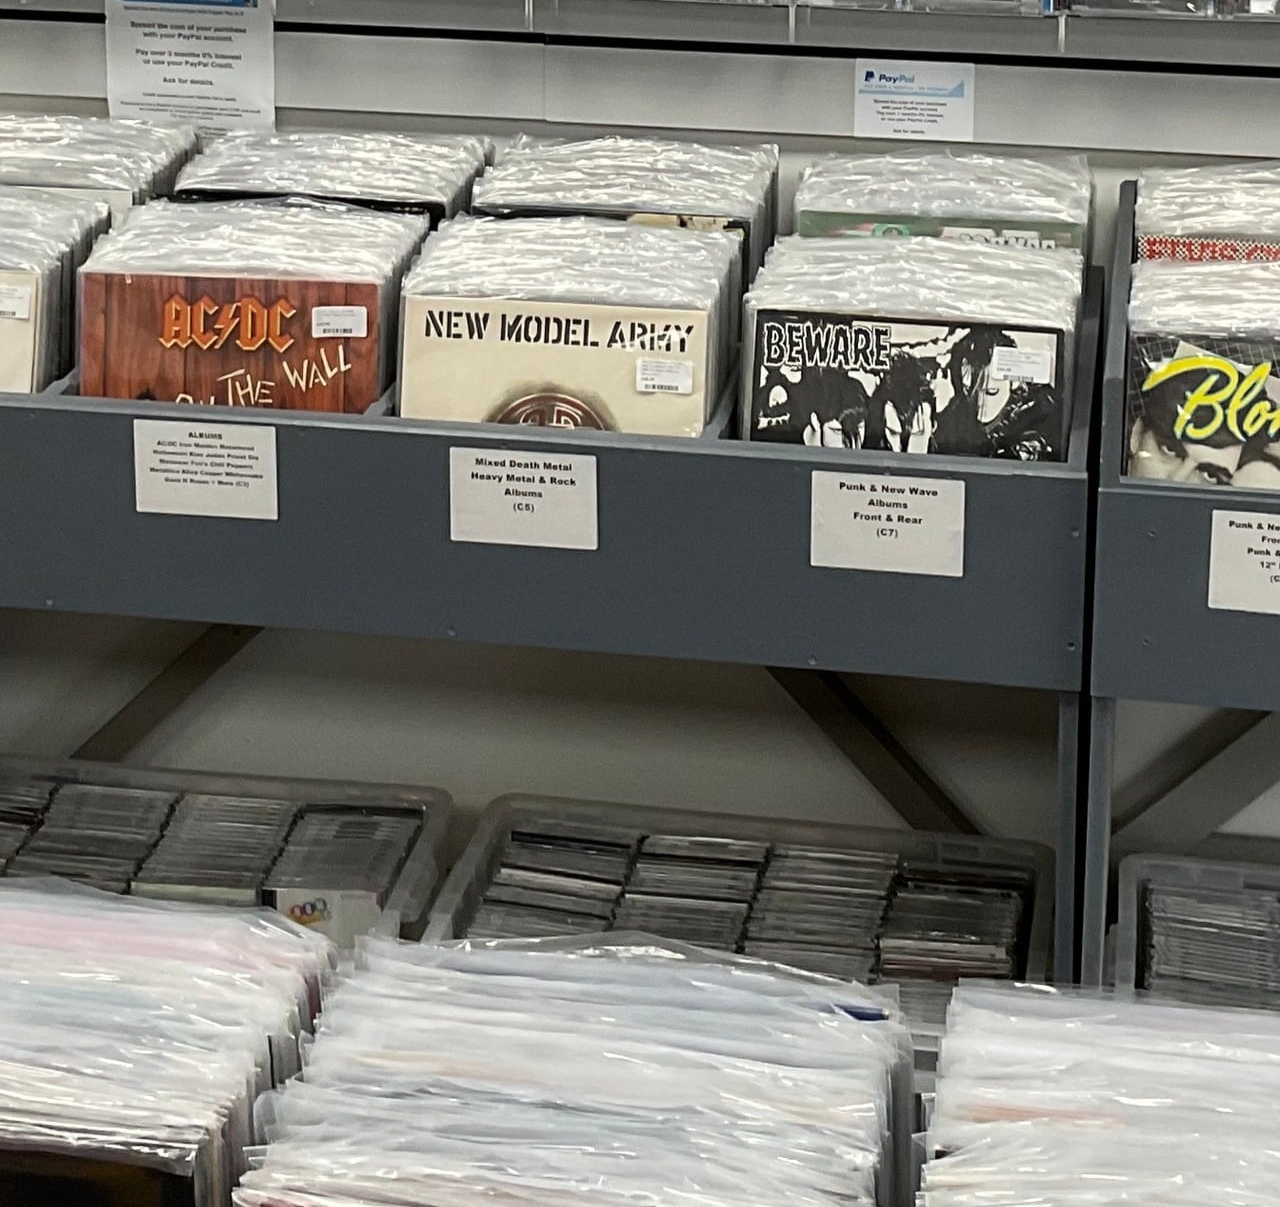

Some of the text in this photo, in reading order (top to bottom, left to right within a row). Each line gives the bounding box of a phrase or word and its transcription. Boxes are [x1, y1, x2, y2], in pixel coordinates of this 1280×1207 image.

[879, 74, 915, 84] PayPal
[424, 310, 695, 353] NEW MODEL ARMY
[763, 321, 892, 371] BEWARE
[217, 344, 352, 407] THE WALL
[188, 432, 223, 440] ALBUMS
[474, 457, 573, 472] Mixed Death Metal
[470, 471, 577, 486] Heavy Metal & Rock
[504, 487, 543, 498] Albums
[839, 482, 939, 497] Punk & New Wave
[868, 499, 909, 510] Albums
[853, 512, 923, 525] Front & Rear
[876, 527, 899, 539] (C7)
